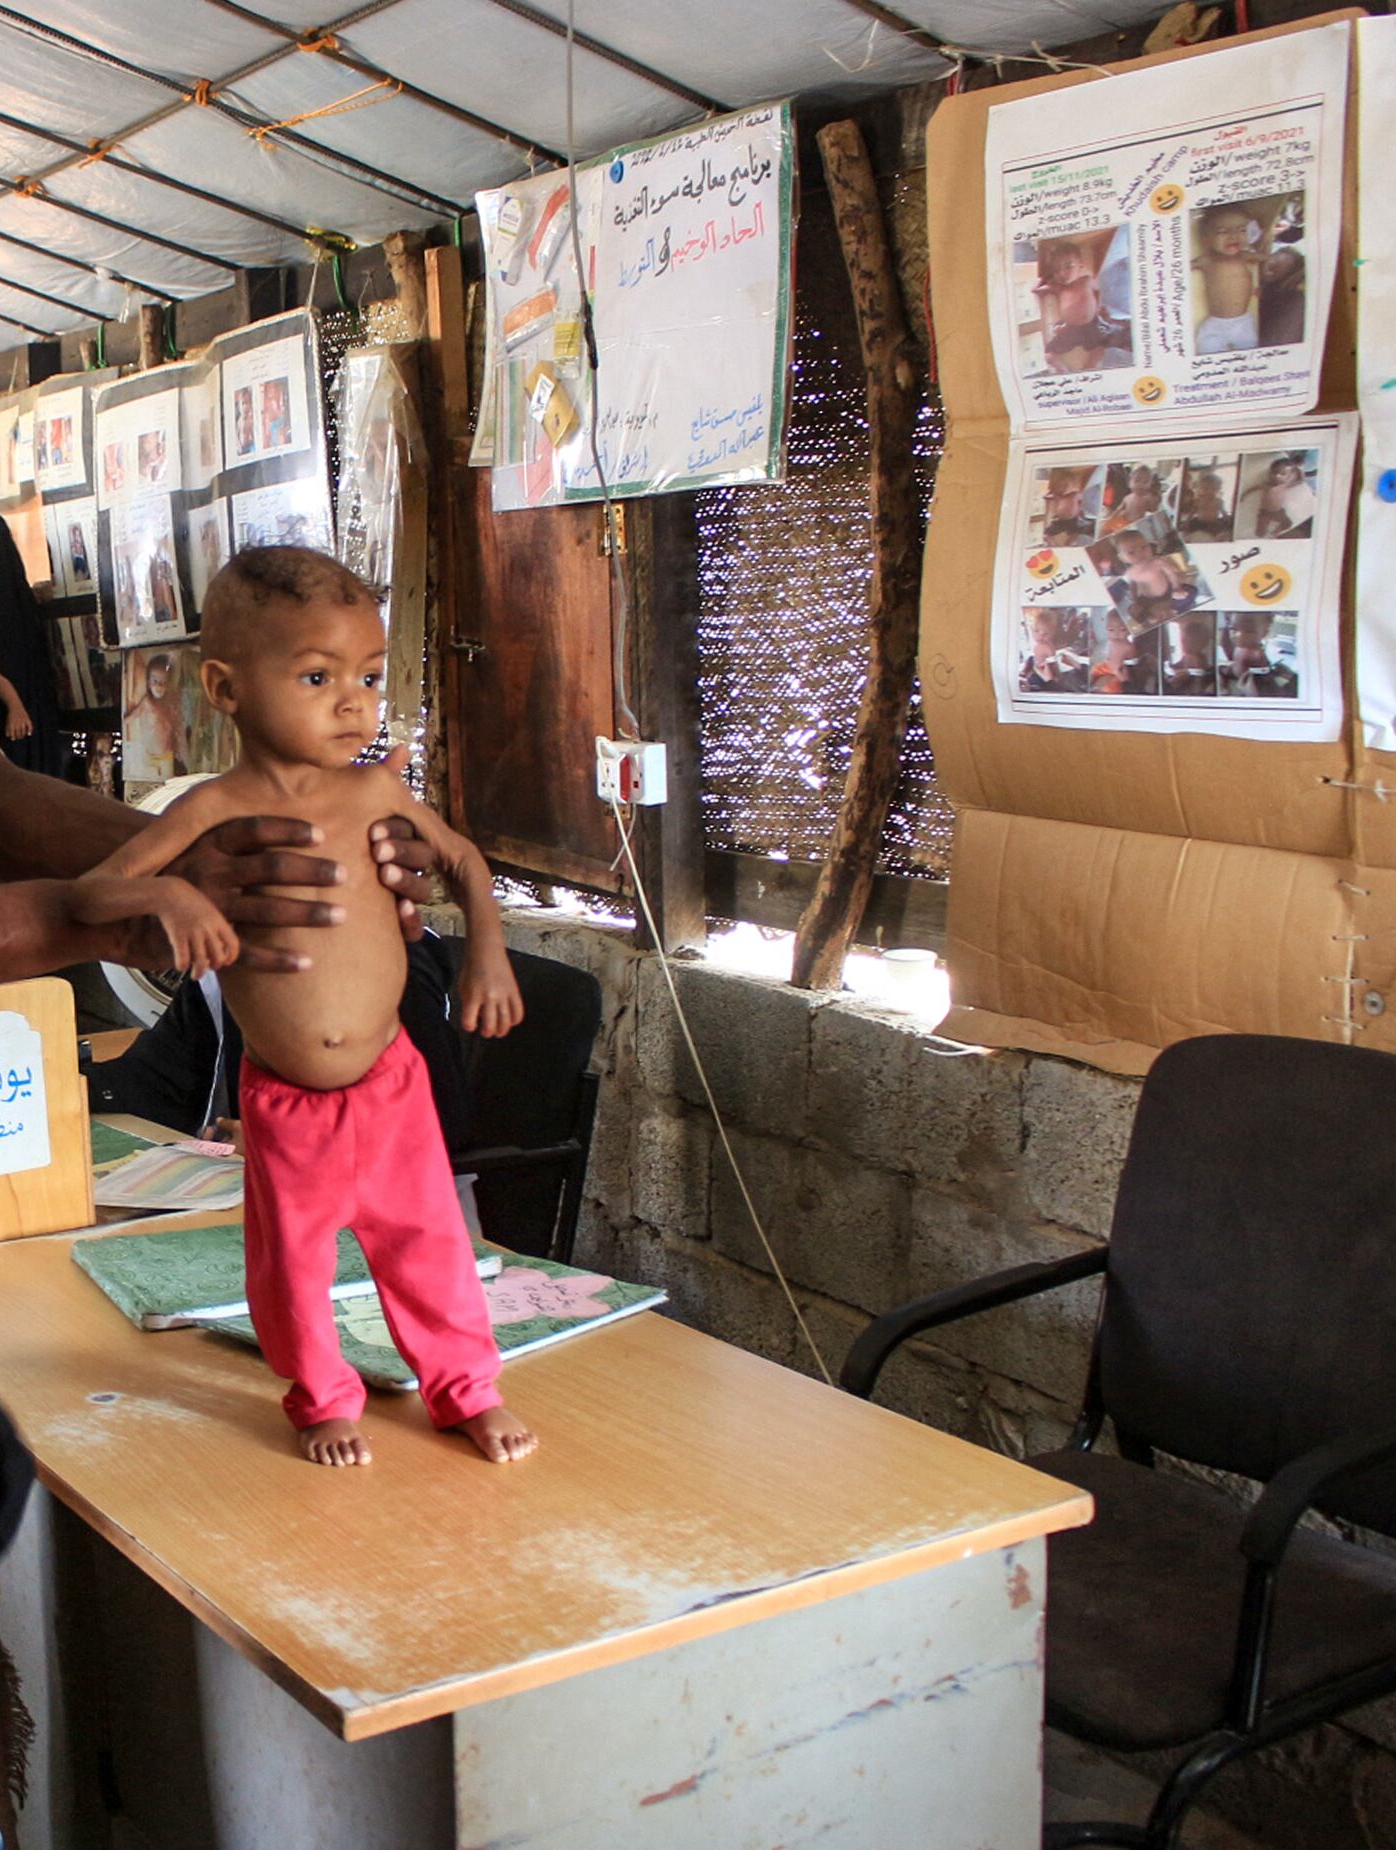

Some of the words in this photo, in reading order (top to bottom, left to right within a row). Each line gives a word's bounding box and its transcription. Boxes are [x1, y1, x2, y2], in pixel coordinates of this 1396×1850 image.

[1163, 146, 1188, 172] camp
[1191, 146, 1214, 157] first
[1218, 140, 1242, 151] visit
[1285, 141, 1311, 152] 7kg
[682, 158, 727, 204] معالجة
[728, 144, 772, 207] برنامج
[1083, 178, 1112, 191] 8.9kg
[1218, 174, 1276, 193] z-score
[613, 185, 649, 232] التغذية
[650, 185, 679, 214] سوء
[720, 200, 764, 249] الحاد
[1038, 210, 1079, 224] z-score
[1173, 381, 1229, 393] Treatment
[1174, 393, 1222, 405] Abdullah
[1217, 546, 1261, 574] صور
[1024, 564, 1085, 602] المتابعة
